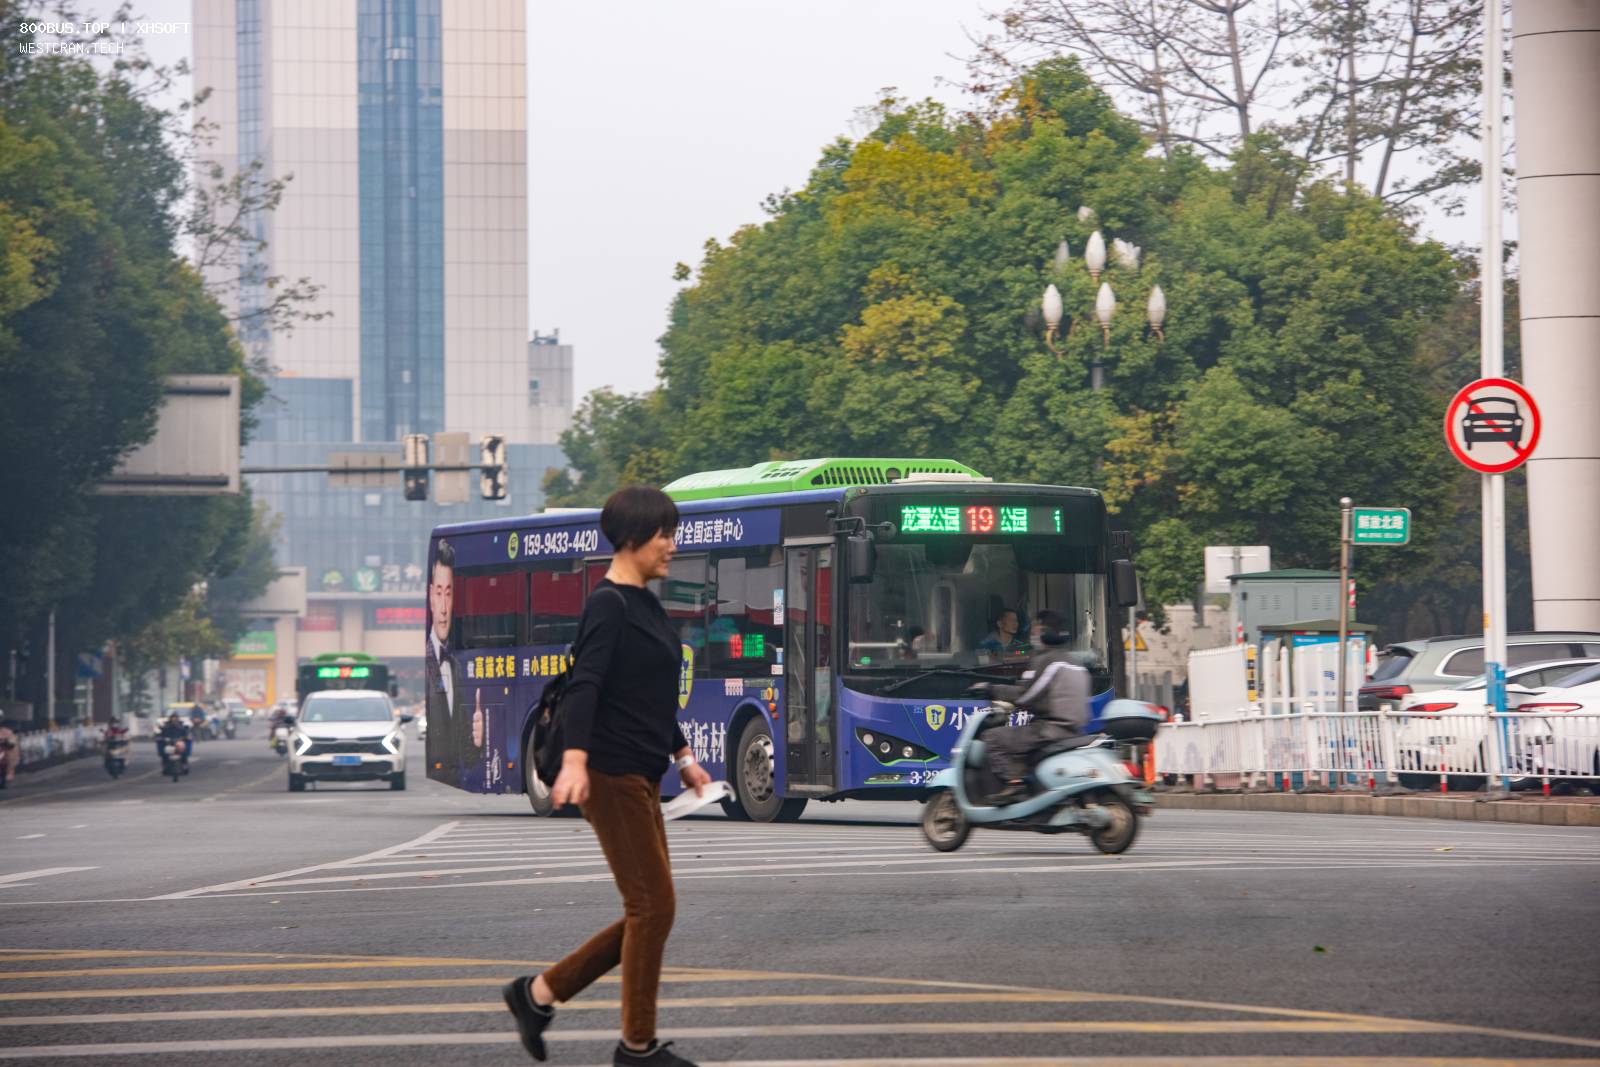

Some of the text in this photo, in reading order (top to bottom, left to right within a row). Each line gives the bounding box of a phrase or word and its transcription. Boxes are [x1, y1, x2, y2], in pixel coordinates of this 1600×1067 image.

[968, 506, 994, 532] 19
[1000, 507, 1027, 532] 公园
[1054, 509, 1061, 532] 1
[523, 529, 598, 556] 159-9433-4420
